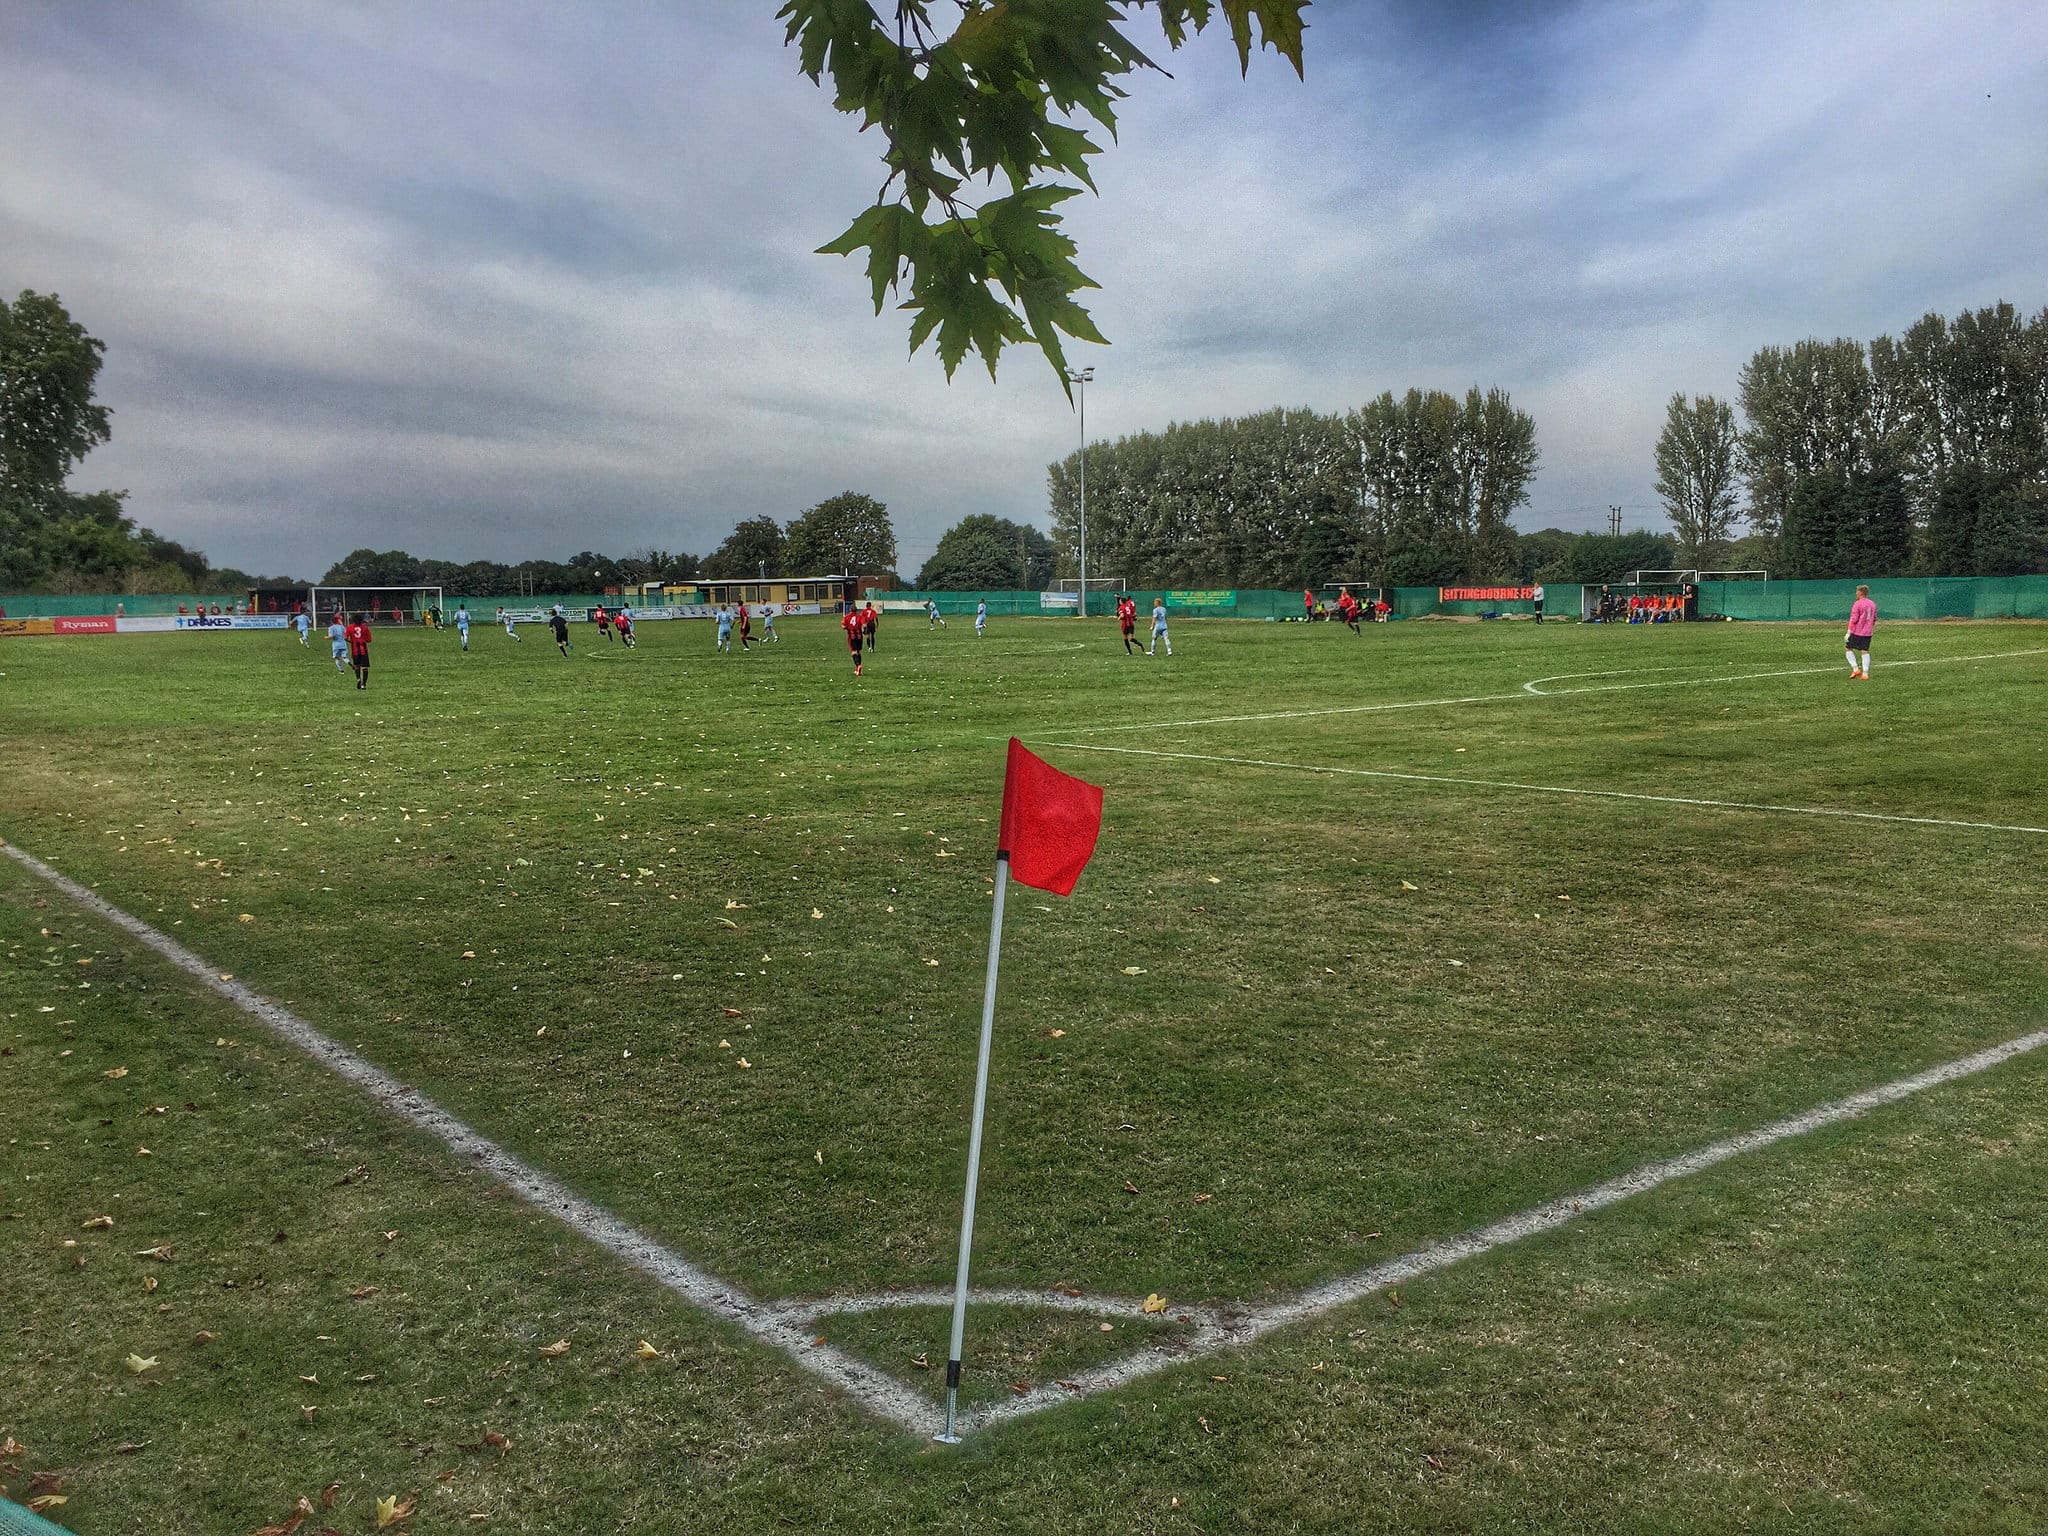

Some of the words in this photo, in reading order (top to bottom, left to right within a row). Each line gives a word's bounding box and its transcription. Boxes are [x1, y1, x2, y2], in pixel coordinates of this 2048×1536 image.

[1444, 588, 1518, 600] SITTINGBOURNE
[61, 621, 109, 629] Ryman
[187, 617, 232, 627] DRAKES
[849, 616, 857, 627] 4
[354, 626, 362, 638] 3
